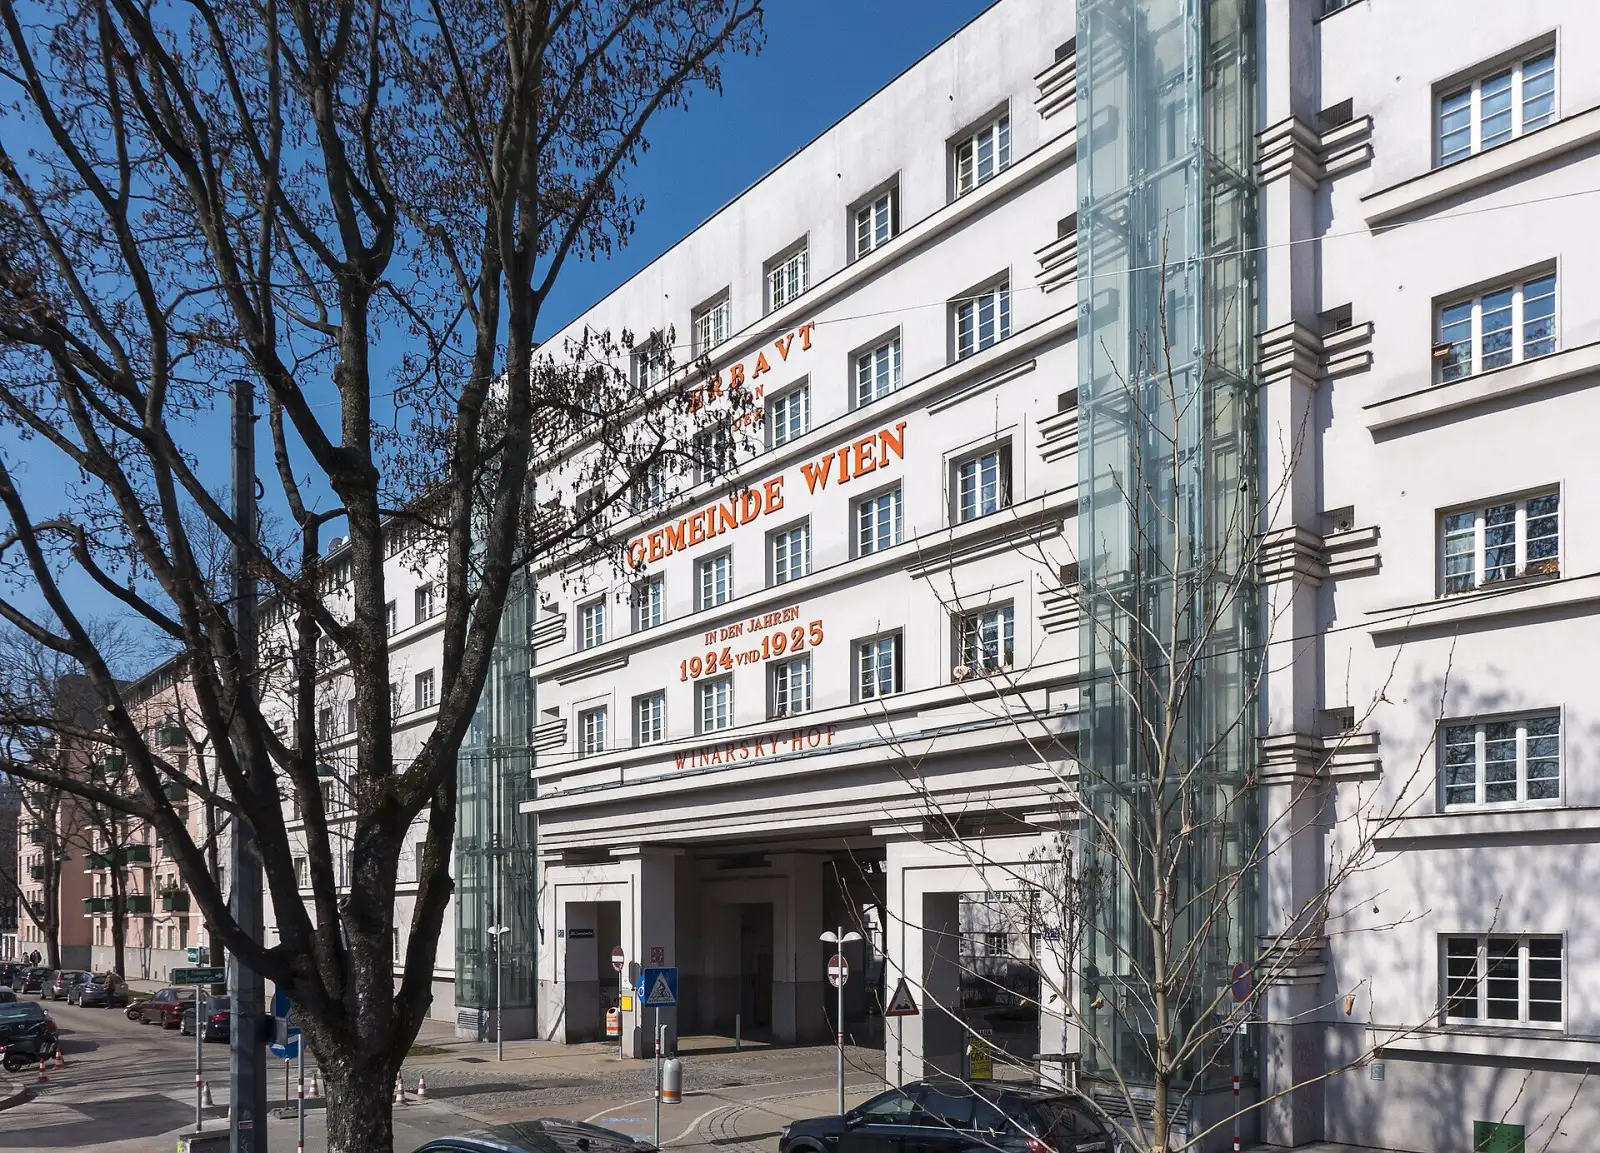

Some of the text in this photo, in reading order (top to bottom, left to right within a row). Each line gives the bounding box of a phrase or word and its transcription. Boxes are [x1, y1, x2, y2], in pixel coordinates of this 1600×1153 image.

[626, 421, 907, 570] GEMEINDE WIEN
[680, 619, 824, 682] 1924 VND 1925
[704, 605, 800, 646] IN DEN JAHREN
